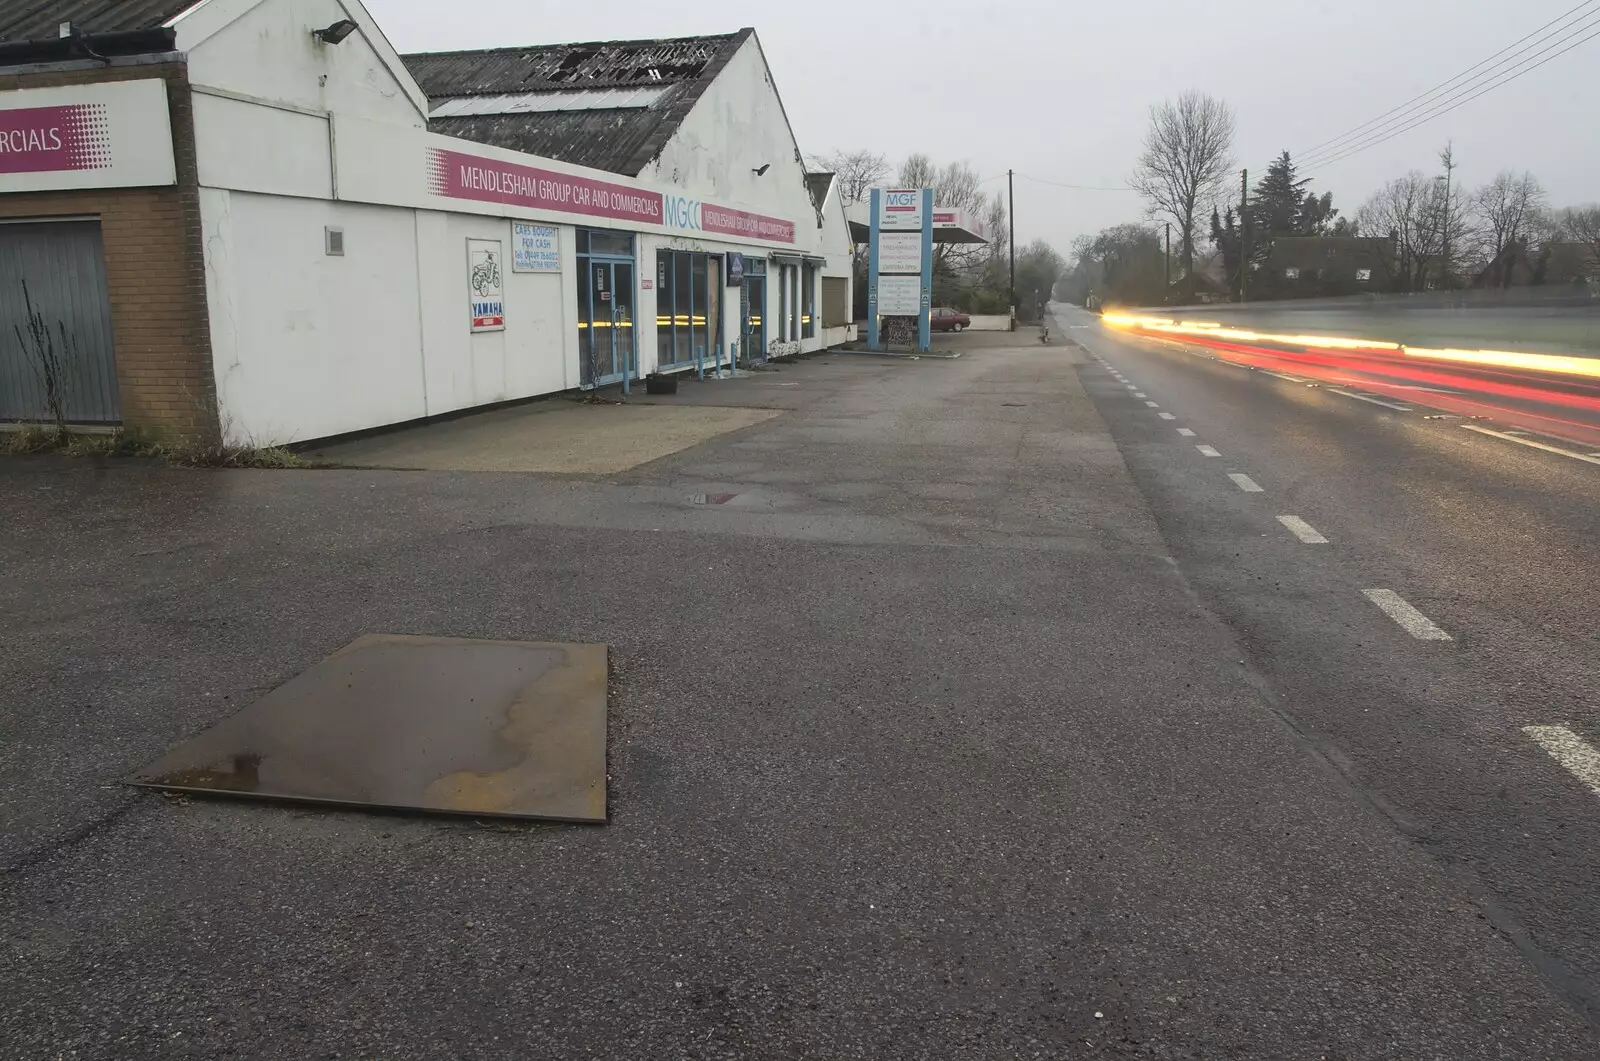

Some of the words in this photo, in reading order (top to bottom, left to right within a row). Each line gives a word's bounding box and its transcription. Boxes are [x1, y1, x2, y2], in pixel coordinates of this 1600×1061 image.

[461, 165, 536, 197] MENDLESHAM
[539, 180, 571, 202] GROUP
[573, 186, 590, 205] CAR
[592, 190, 609, 209] AND
[611, 193, 658, 216] COMMERCIALS
[886, 194, 916, 205] MGF
[665, 195, 700, 230] MGCC
[522, 238, 534, 248] FOR
[536, 239, 551, 249] CASH
[472, 302, 503, 317] YAMAHA
